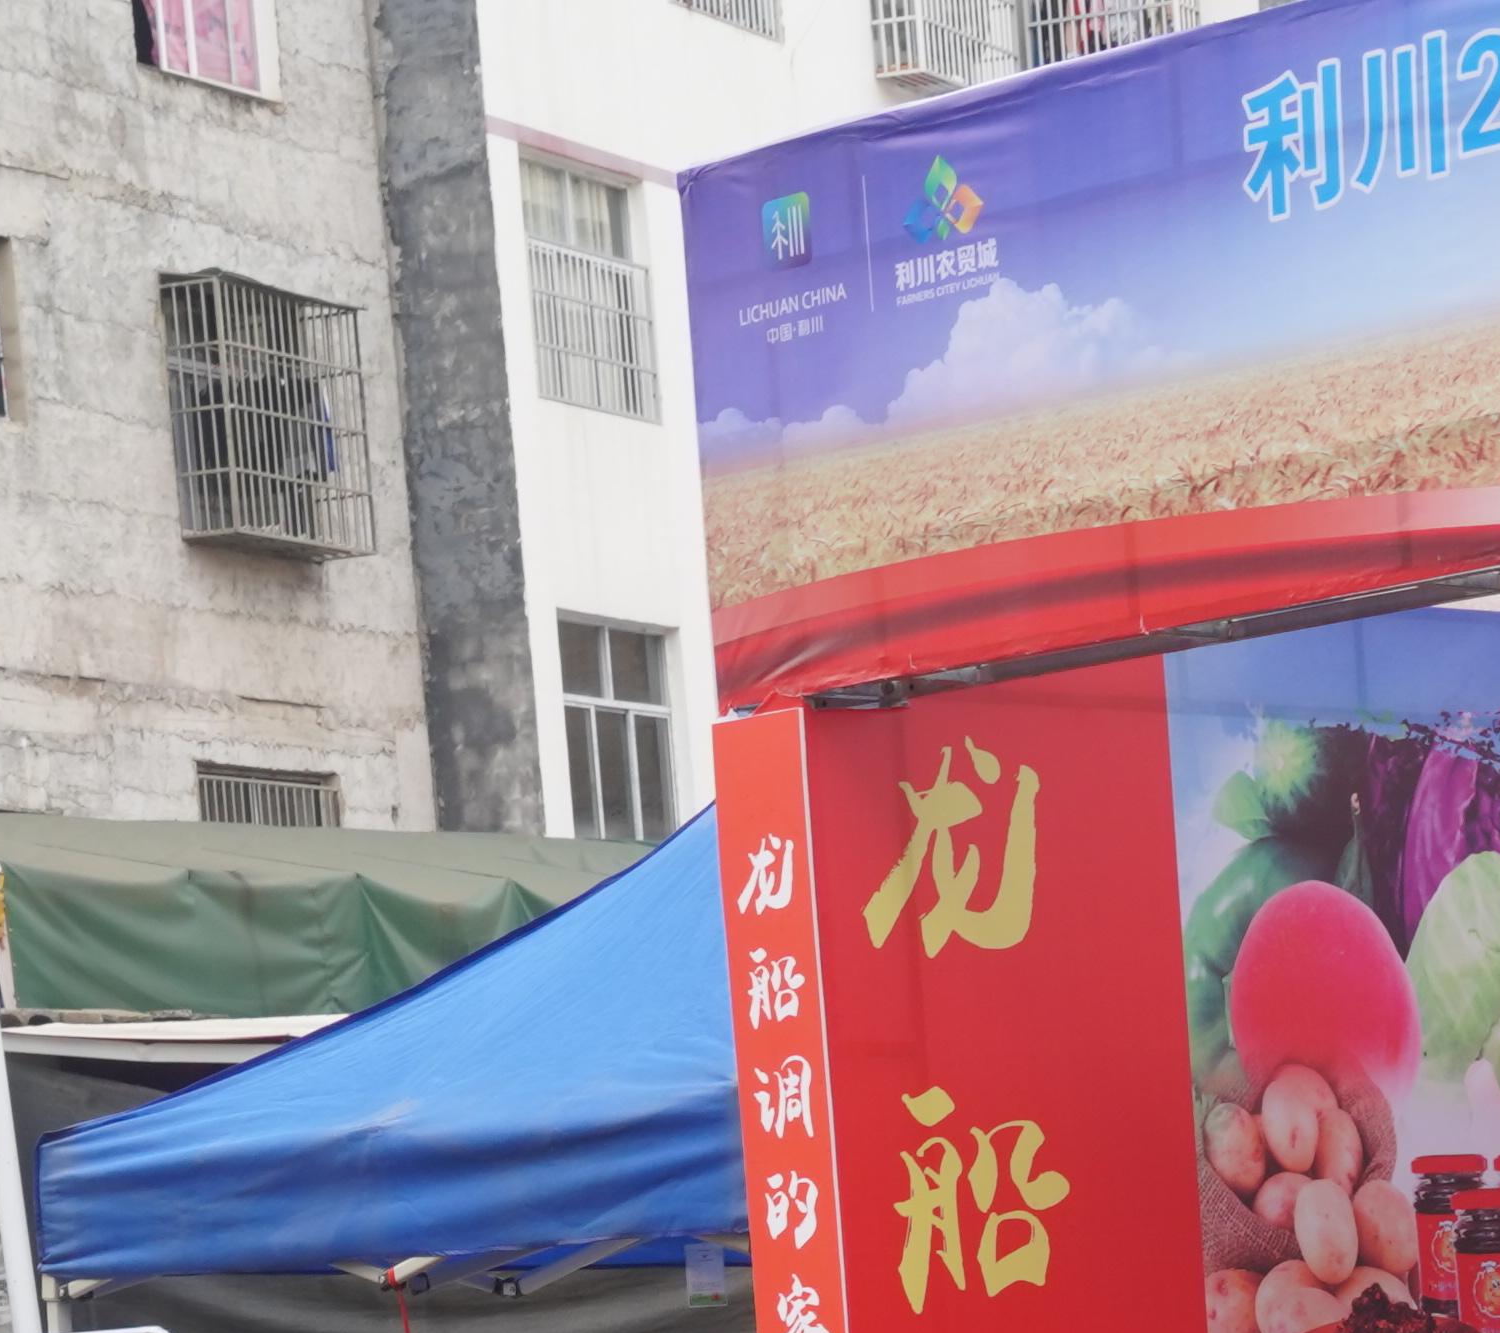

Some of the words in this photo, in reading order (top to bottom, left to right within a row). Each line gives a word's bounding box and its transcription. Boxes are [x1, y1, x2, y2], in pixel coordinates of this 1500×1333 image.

[895, 238, 999, 293] 利川农贸城
[739, 297, 799, 327] LICHUAN
[801, 283, 847, 310] CHINA
